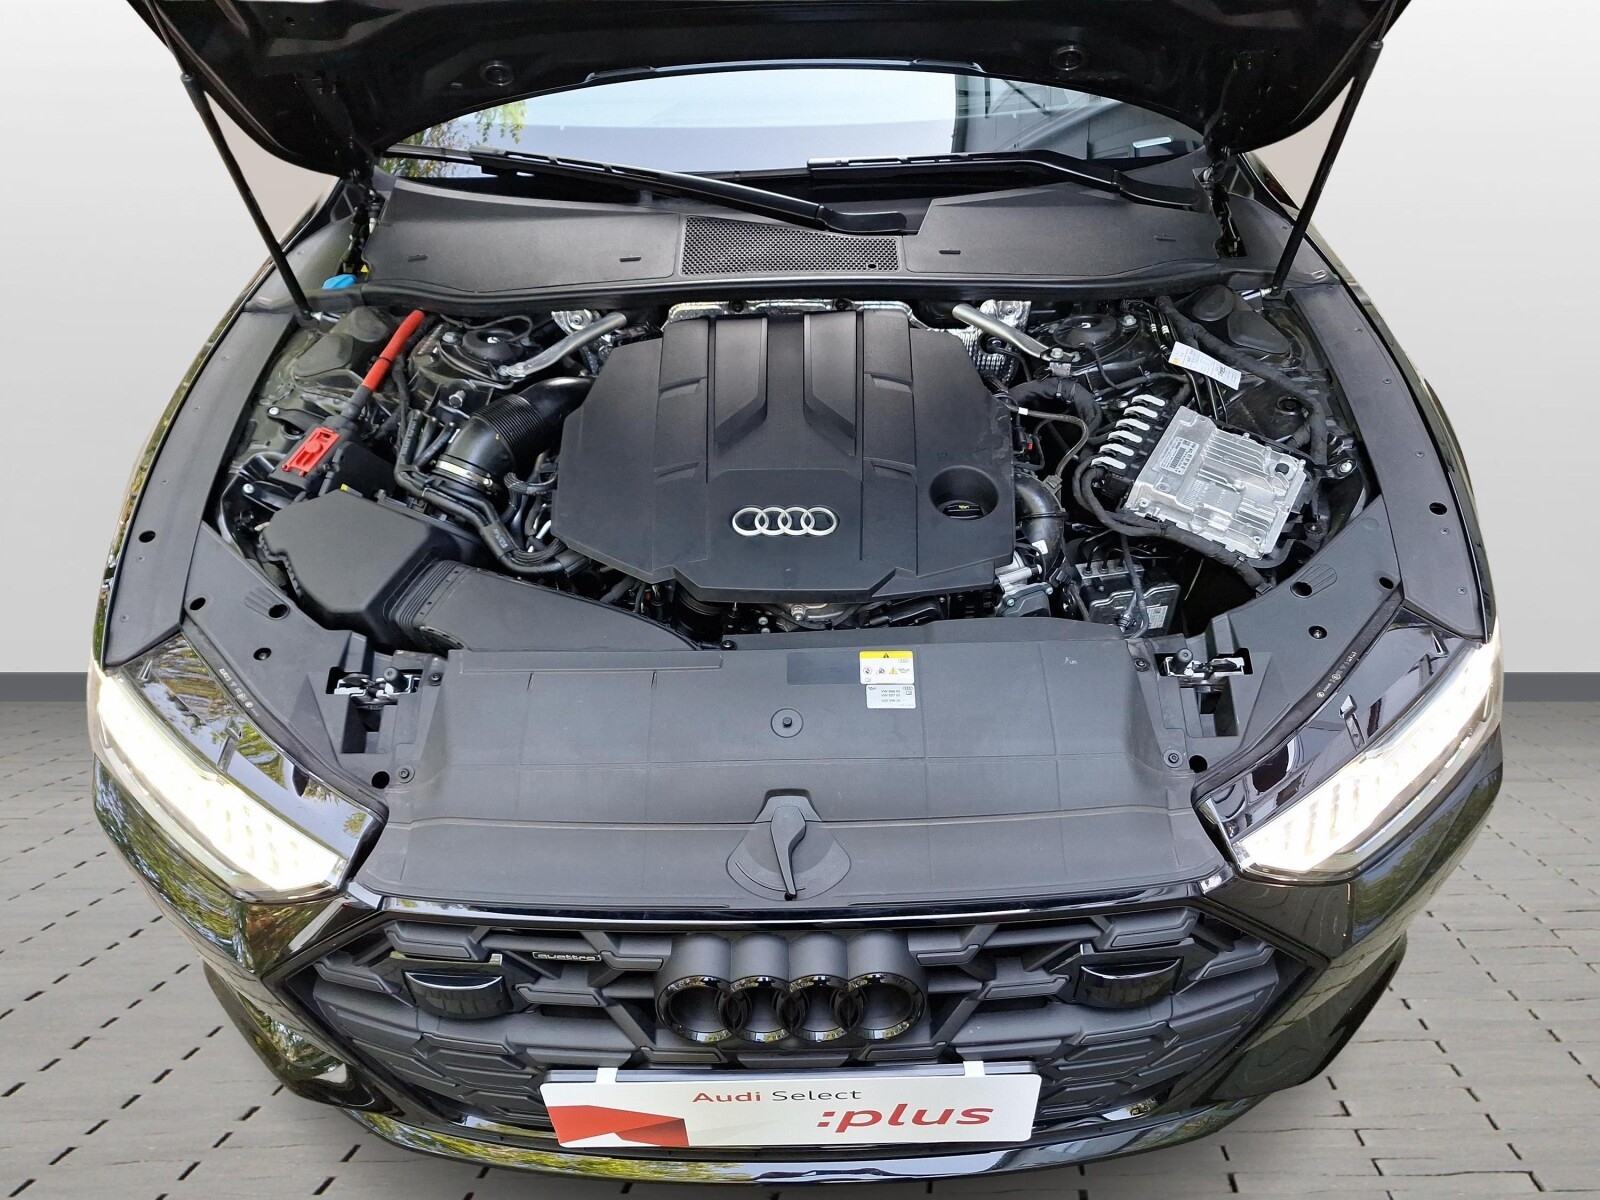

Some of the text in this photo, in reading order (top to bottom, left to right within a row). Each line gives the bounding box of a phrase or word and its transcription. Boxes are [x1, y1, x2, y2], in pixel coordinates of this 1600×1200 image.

[537, 953, 596, 961] quattro
[692, 1089, 862, 1103] Audi Select
